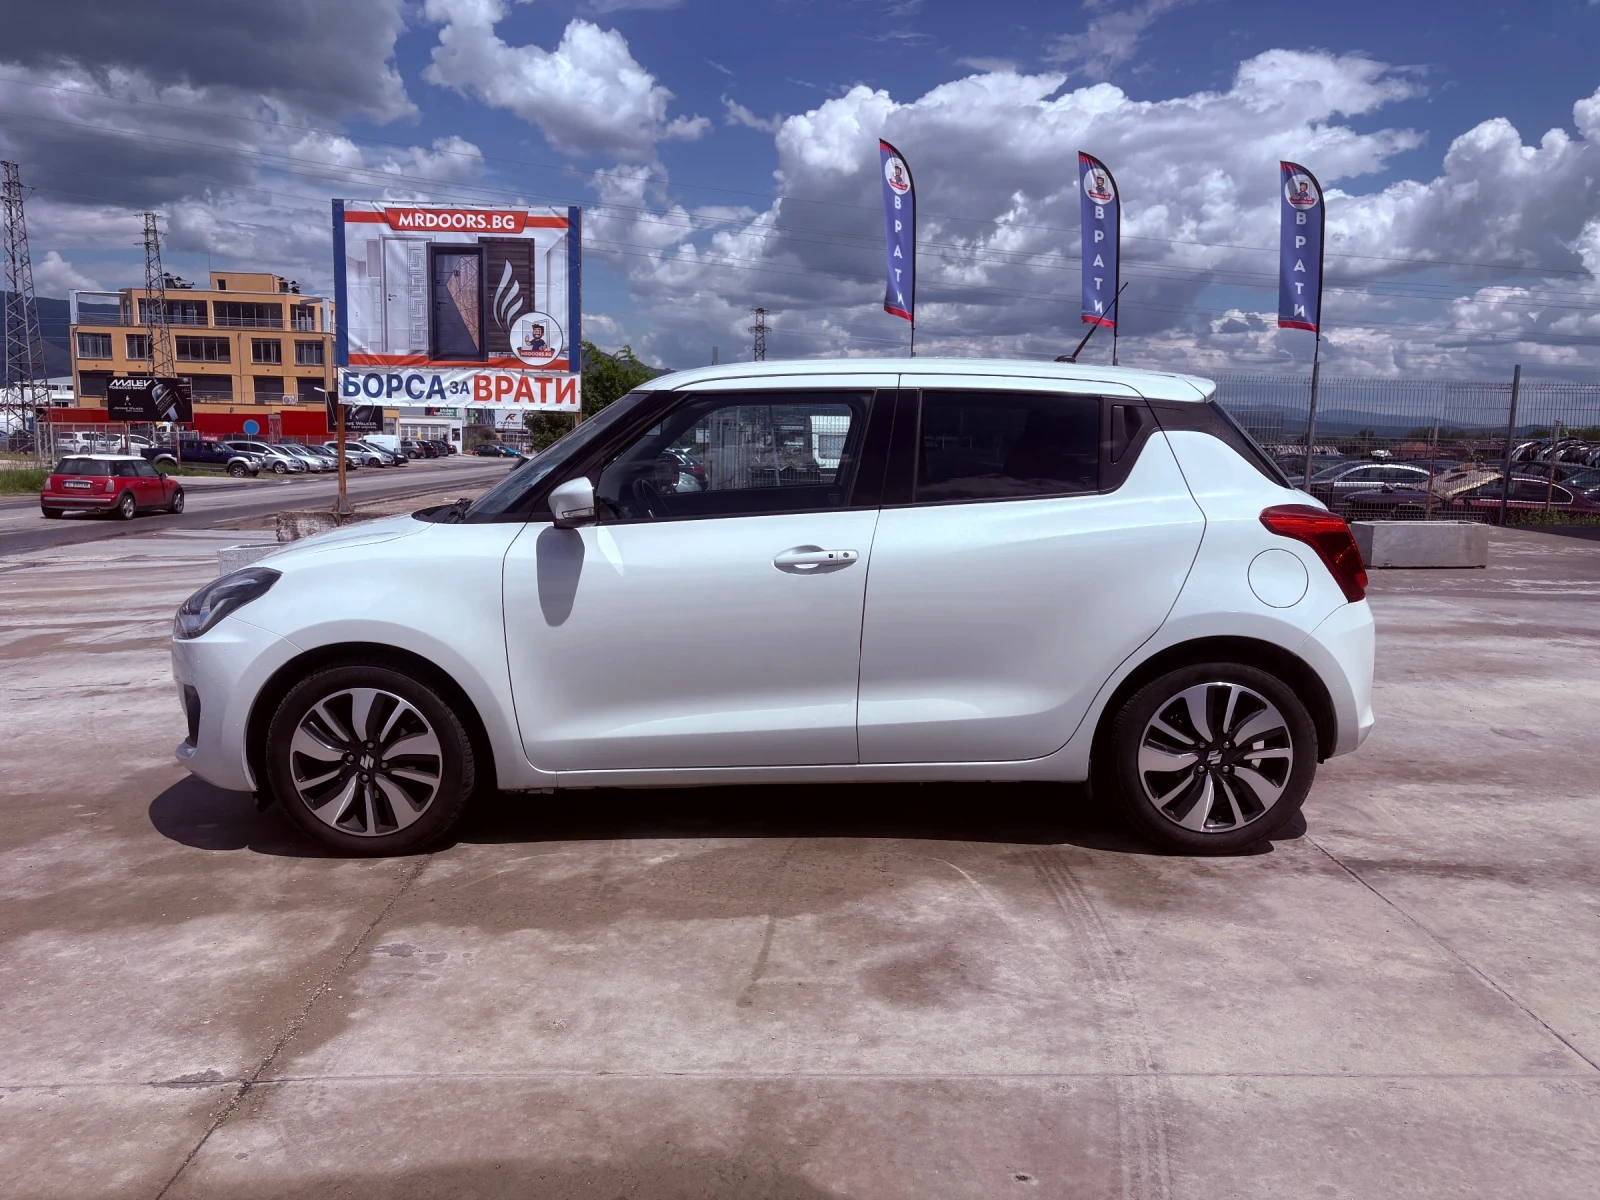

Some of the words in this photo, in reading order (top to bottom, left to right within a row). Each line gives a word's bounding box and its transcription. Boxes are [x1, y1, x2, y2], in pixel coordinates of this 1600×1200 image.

[398, 212, 515, 230] MRDOORS.BG
[893, 195, 904, 306] ВРАТИ
[1093, 205, 1105, 314] ВРАТИ
[1293, 211, 1306, 318] ВРАТИ
[109, 379, 152, 387] MALEV
[342, 371, 447, 400] БОРСА
[449, 380, 470, 395] ЗА
[473, 374, 576, 405] ВРАТИ
